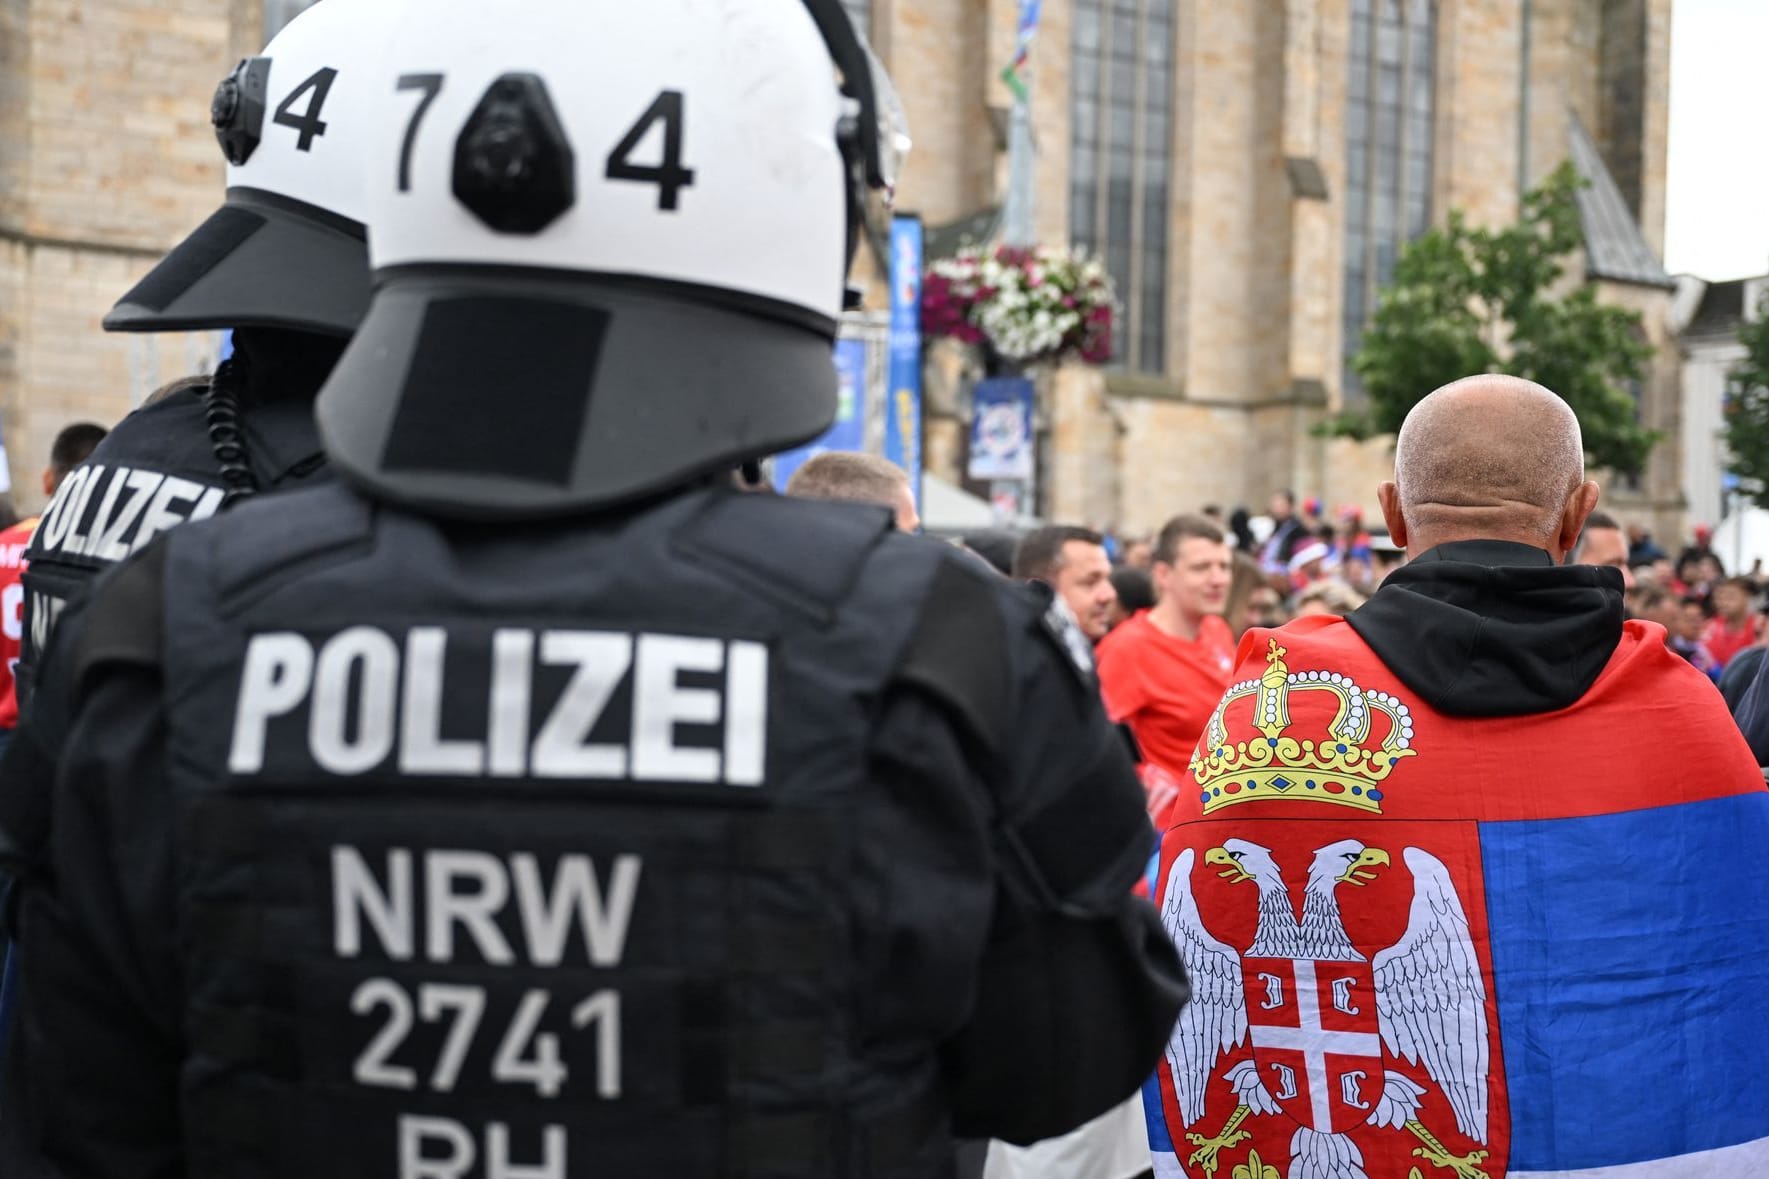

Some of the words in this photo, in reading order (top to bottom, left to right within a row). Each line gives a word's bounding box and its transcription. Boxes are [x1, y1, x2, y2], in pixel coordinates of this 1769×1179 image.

[272, 66, 338, 152] 4
[396, 73, 445, 193] 7
[604, 90, 695, 211] 4
[229, 626, 768, 785] POLIZEI
[331, 846, 641, 966] NRW
[351, 978, 621, 1097] 2741
